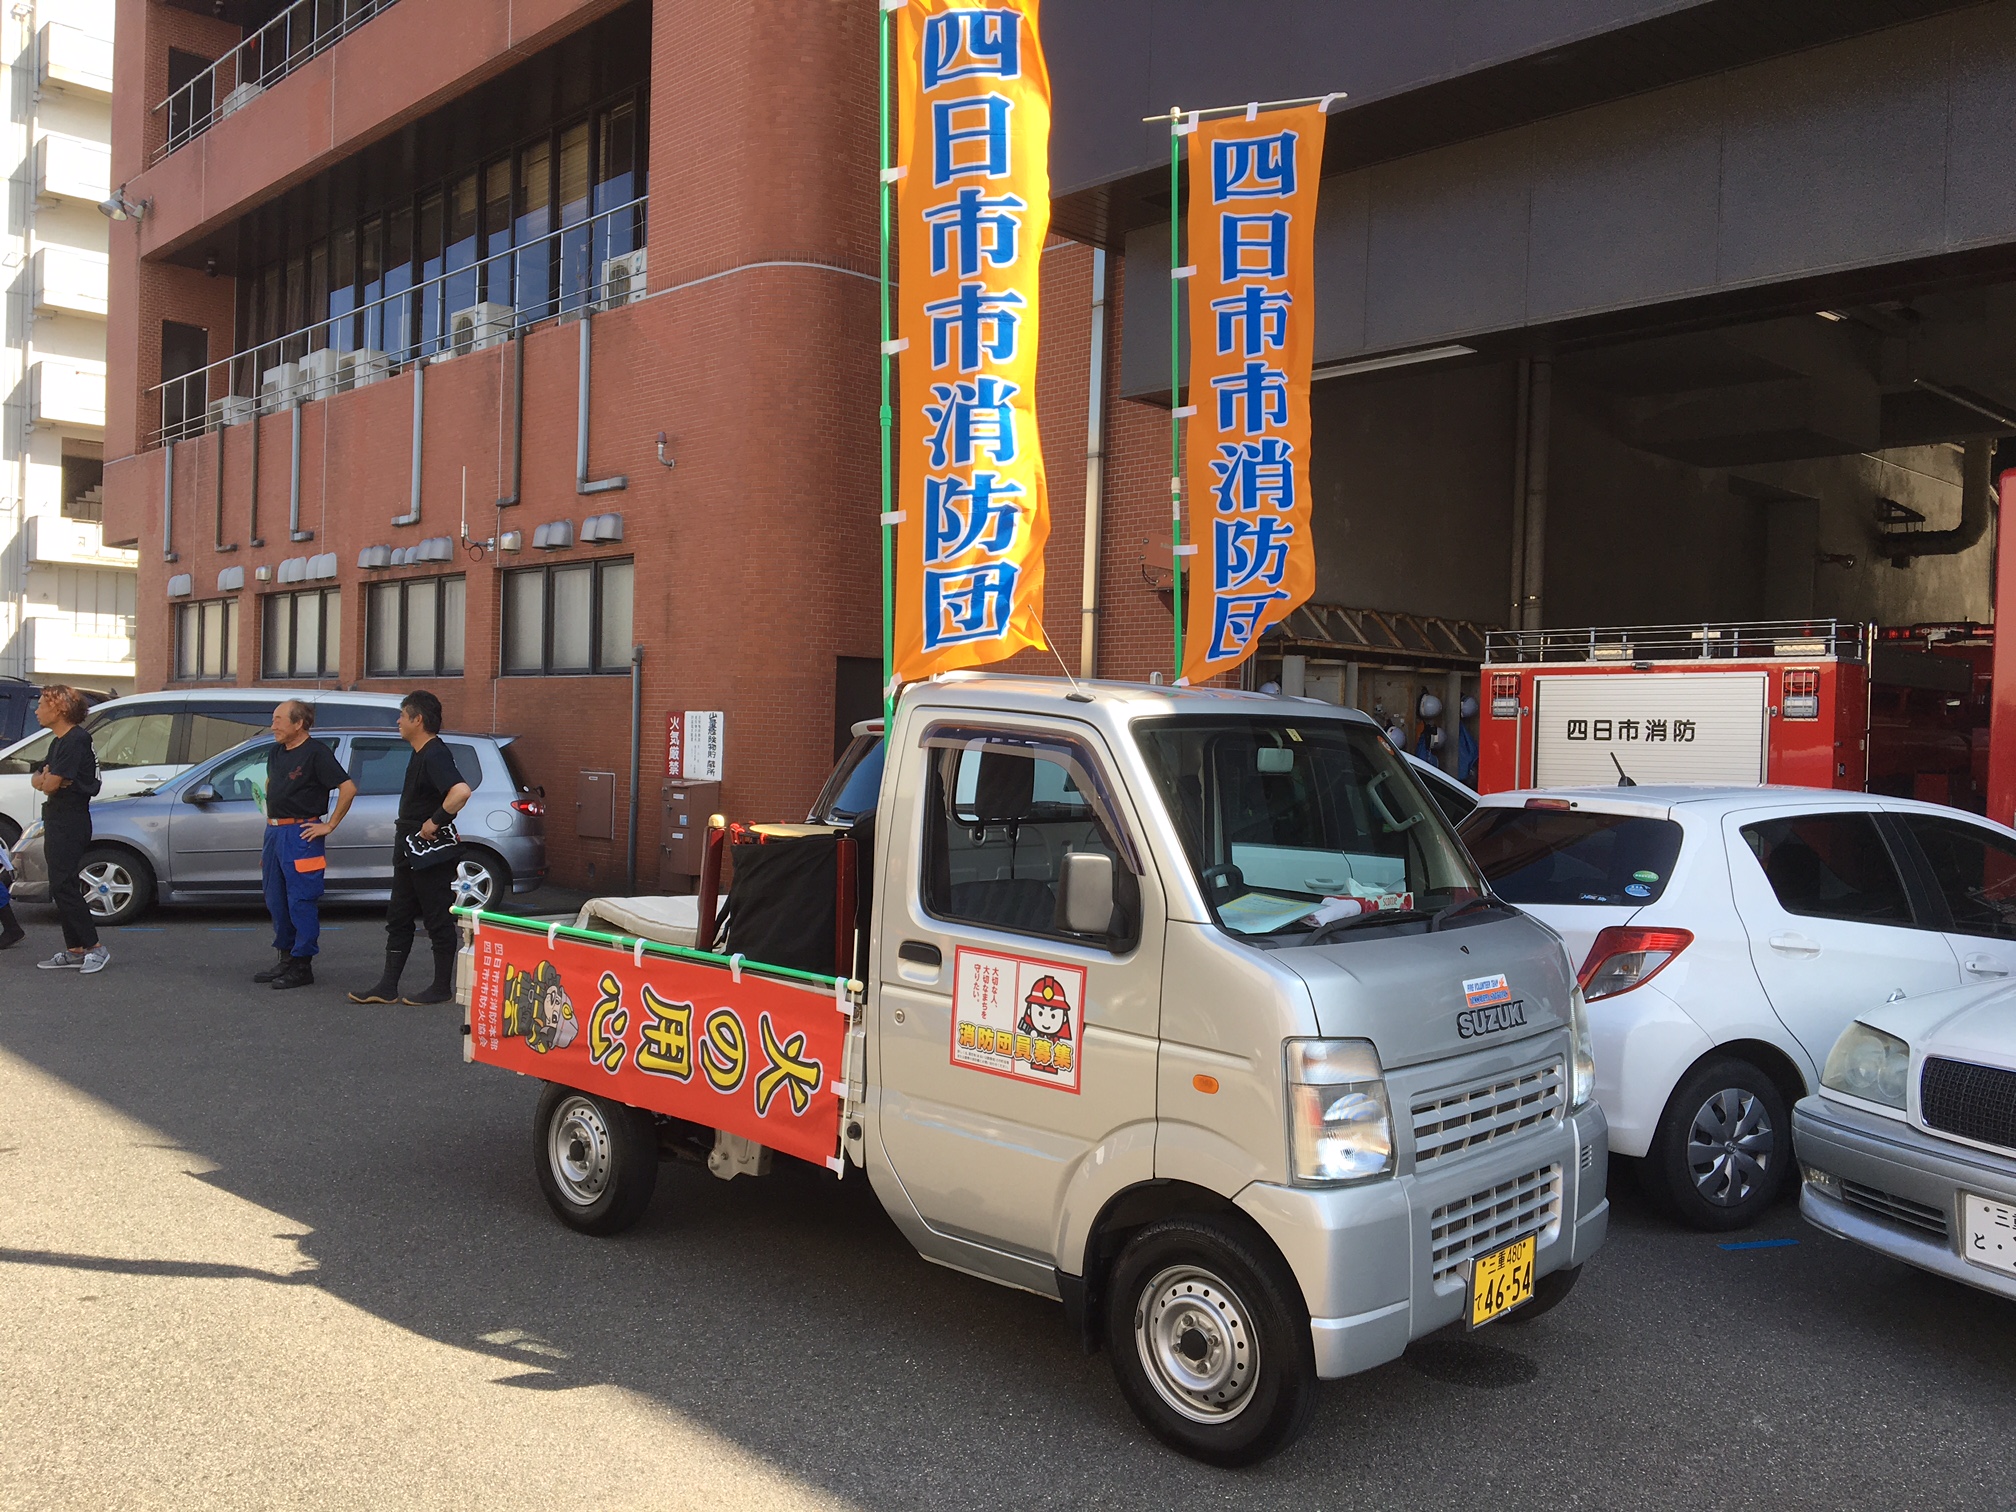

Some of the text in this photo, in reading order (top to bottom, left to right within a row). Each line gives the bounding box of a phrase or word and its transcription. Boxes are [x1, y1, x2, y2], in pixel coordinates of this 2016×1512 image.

[922, 6, 1026, 654] 四日市市消防団
[1206, 128, 1299, 663] 四日市市消防団
[669, 716, 680, 776] 火気厳禁
[1567, 718, 1697, 743] 四日市消防
[489, 942, 503, 1051] 四日市市消防本部
[973, 963, 982, 1003] 守りたい。
[981, 965, 990, 1019] 大切なまちを
[990, 967, 999, 1007] 大切な人、
[588, 969, 824, 1120] 火の用心
[957, 1021, 1074, 1072] 消防団員募集
[1457, 1000, 1527, 1039] SUZUKI
[1488, 1242, 1523, 1276] 三重 480
[1485, 1260, 1531, 1315] 46-54
